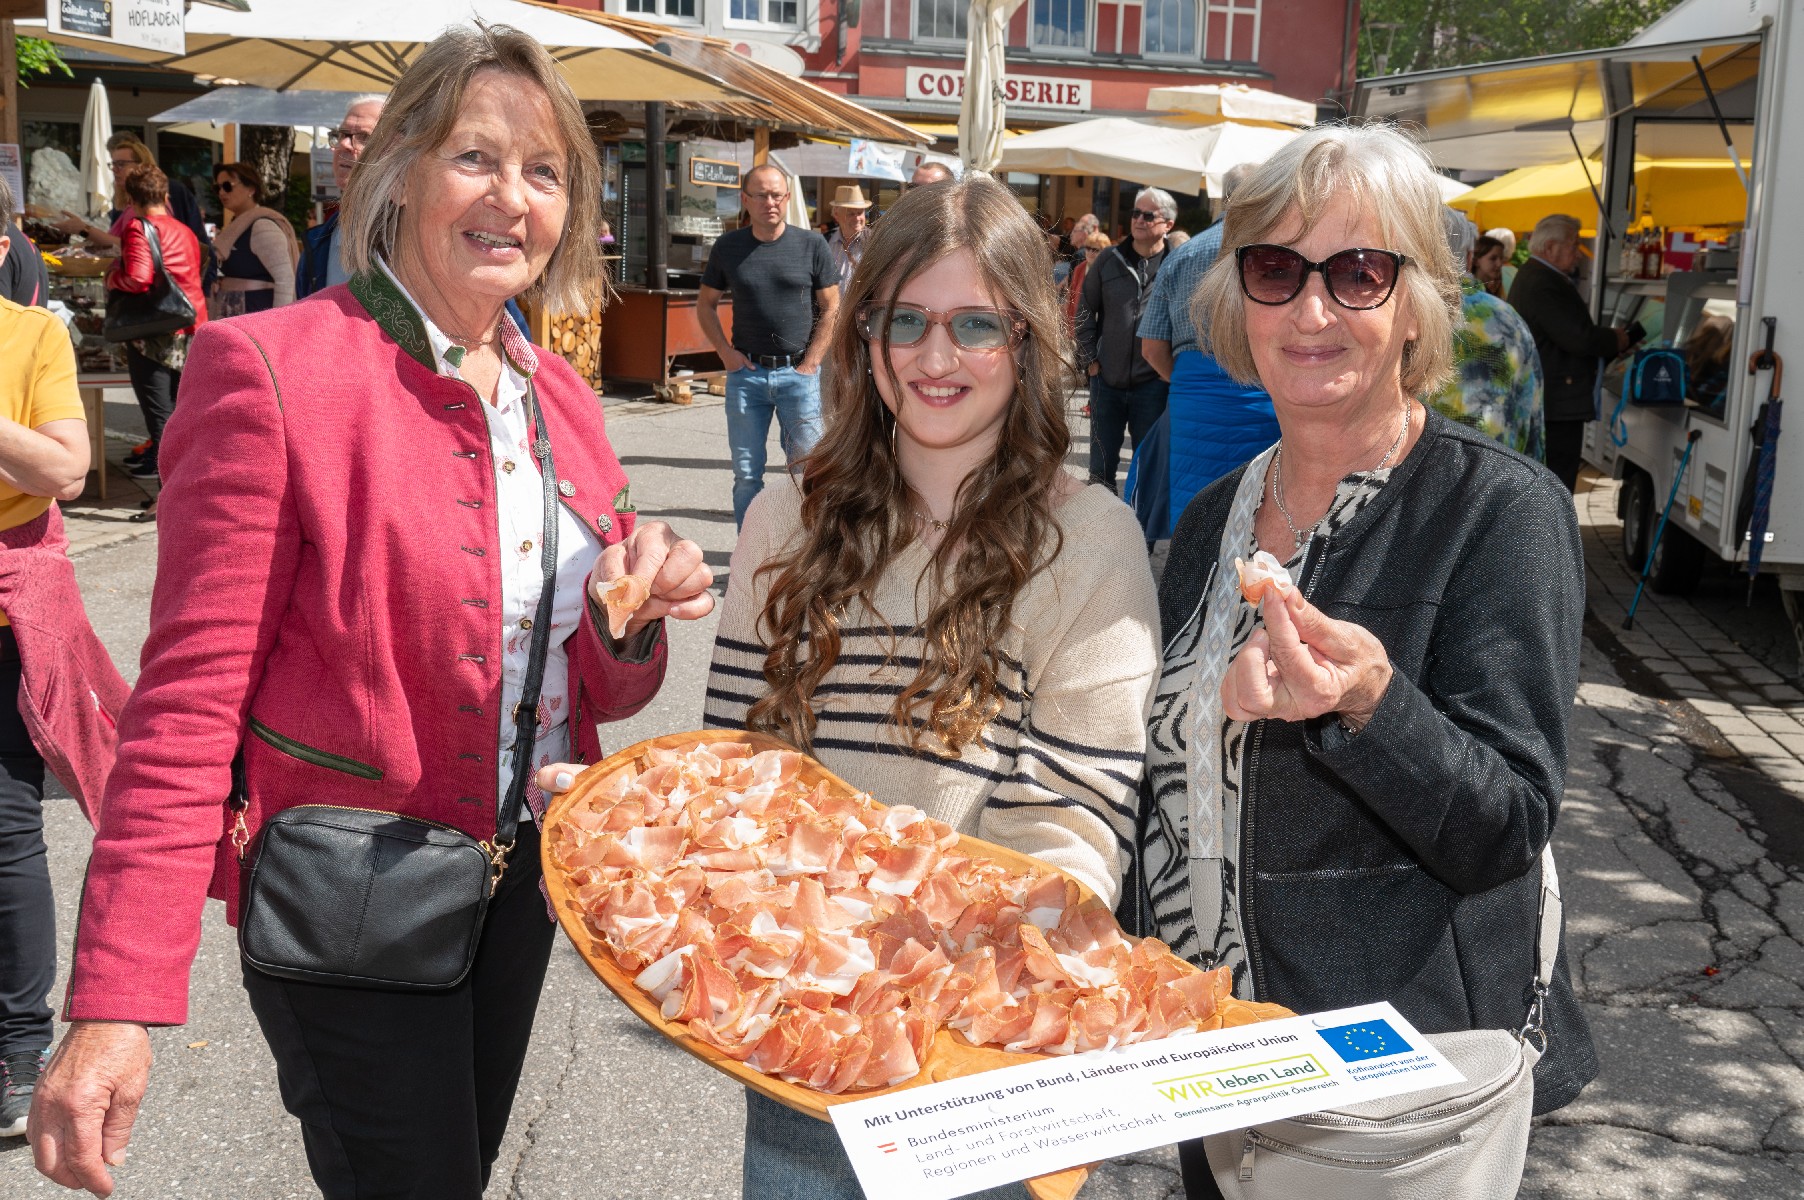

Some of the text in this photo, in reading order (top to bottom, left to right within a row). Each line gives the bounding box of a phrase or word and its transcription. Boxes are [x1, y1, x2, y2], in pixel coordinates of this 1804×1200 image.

[89, 8, 108, 22] Speck
[128, 9, 180, 27] HOFLADEN
[918, 73, 1081, 105] COSERIE
[864, 1033, 1299, 1128] Mit Unterstützung von Bund, Ländern und Europäischer Union
[1157, 1060, 1317, 1103] WIR leben Land
[1346, 1060, 1398, 1074] Kofinanziert
[1398, 1057, 1414, 1065] von
[1353, 1062, 1437, 1082] Europäischen Union
[1174, 1079, 1340, 1119] Gemeinsame Agrarpolitik Österreich
[908, 1106, 1055, 1147] Bundesministerium
[916, 1107, 1121, 1163] Land- und Forstwirtschaft,
[923, 1113, 1166, 1179] Regionen und Wasserwirtschaft
